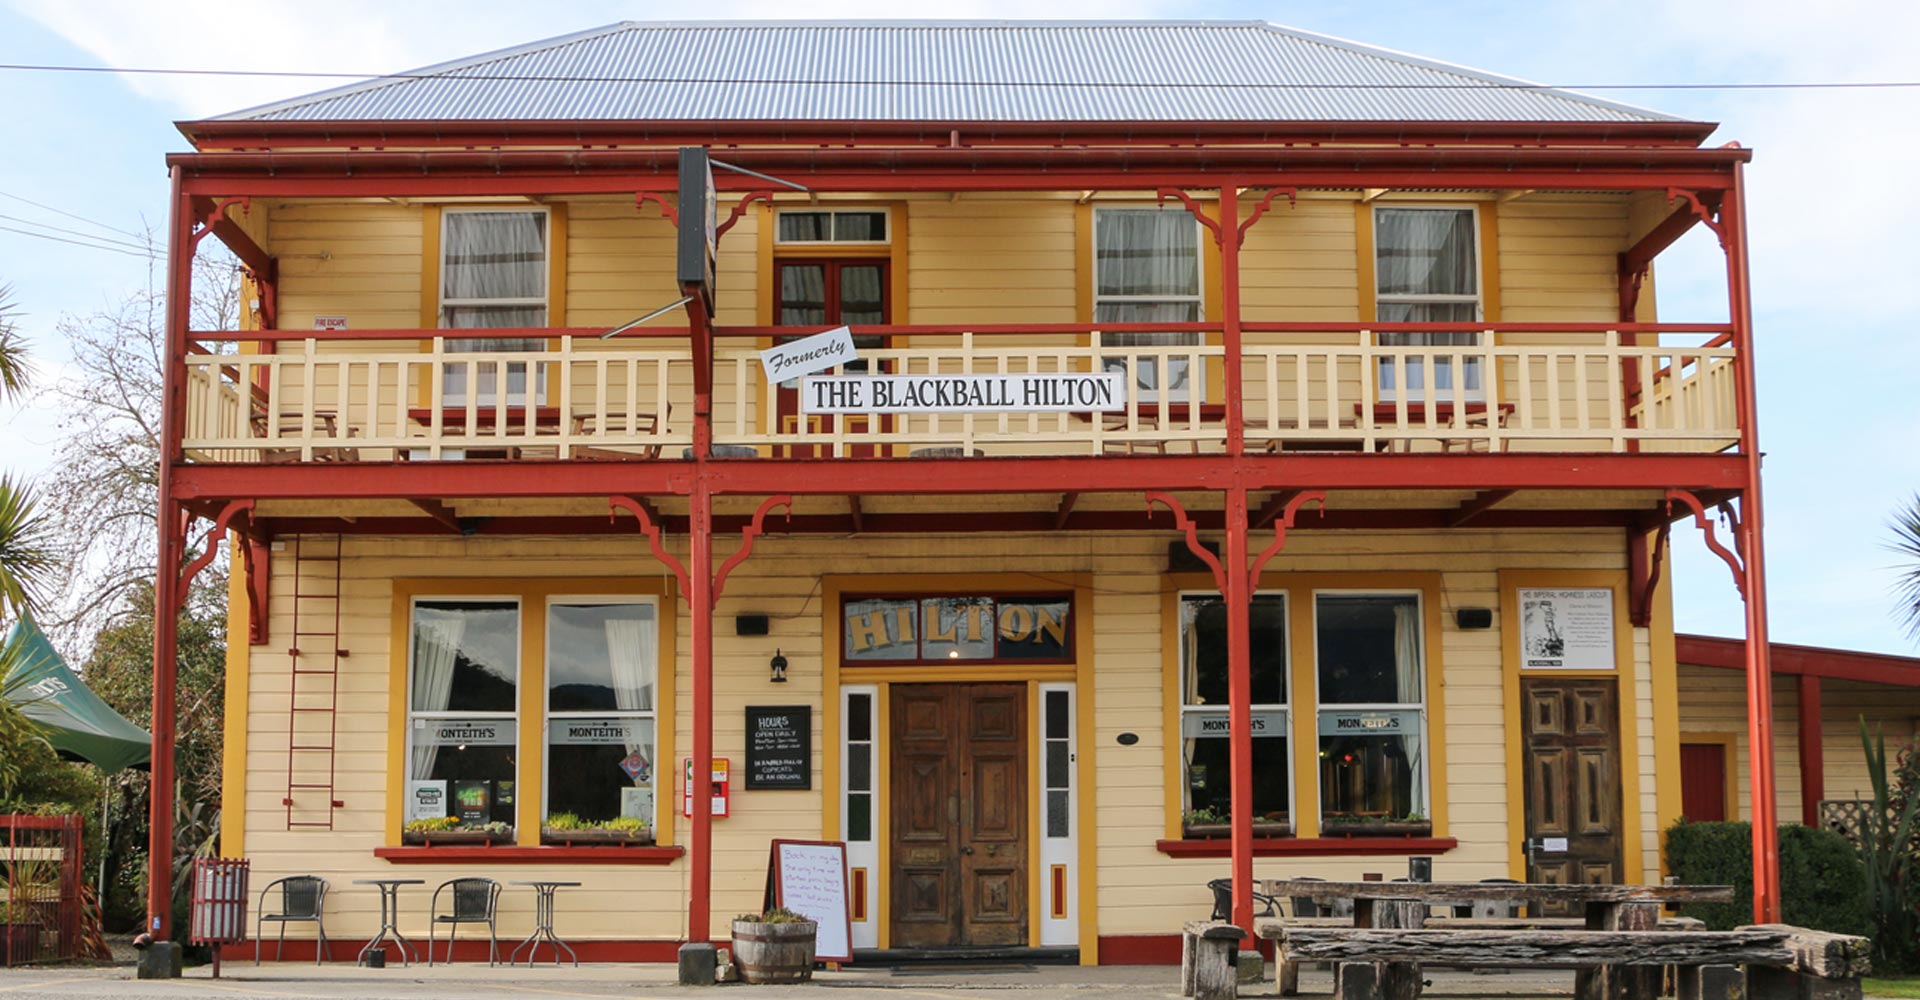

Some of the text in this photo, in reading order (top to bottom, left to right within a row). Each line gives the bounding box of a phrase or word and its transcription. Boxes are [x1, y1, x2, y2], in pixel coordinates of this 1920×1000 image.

[769, 339, 846, 374] Formerly
[812, 378, 1112, 408] THE BLACKBALL HILTON
[849, 604, 1068, 650] HILTON
[758, 716, 789, 728] HOURS
[1203, 720, 1265, 730] MONTH'S
[569, 727, 631, 737] MONTEITH'S
[784, 850, 806, 860] Back
